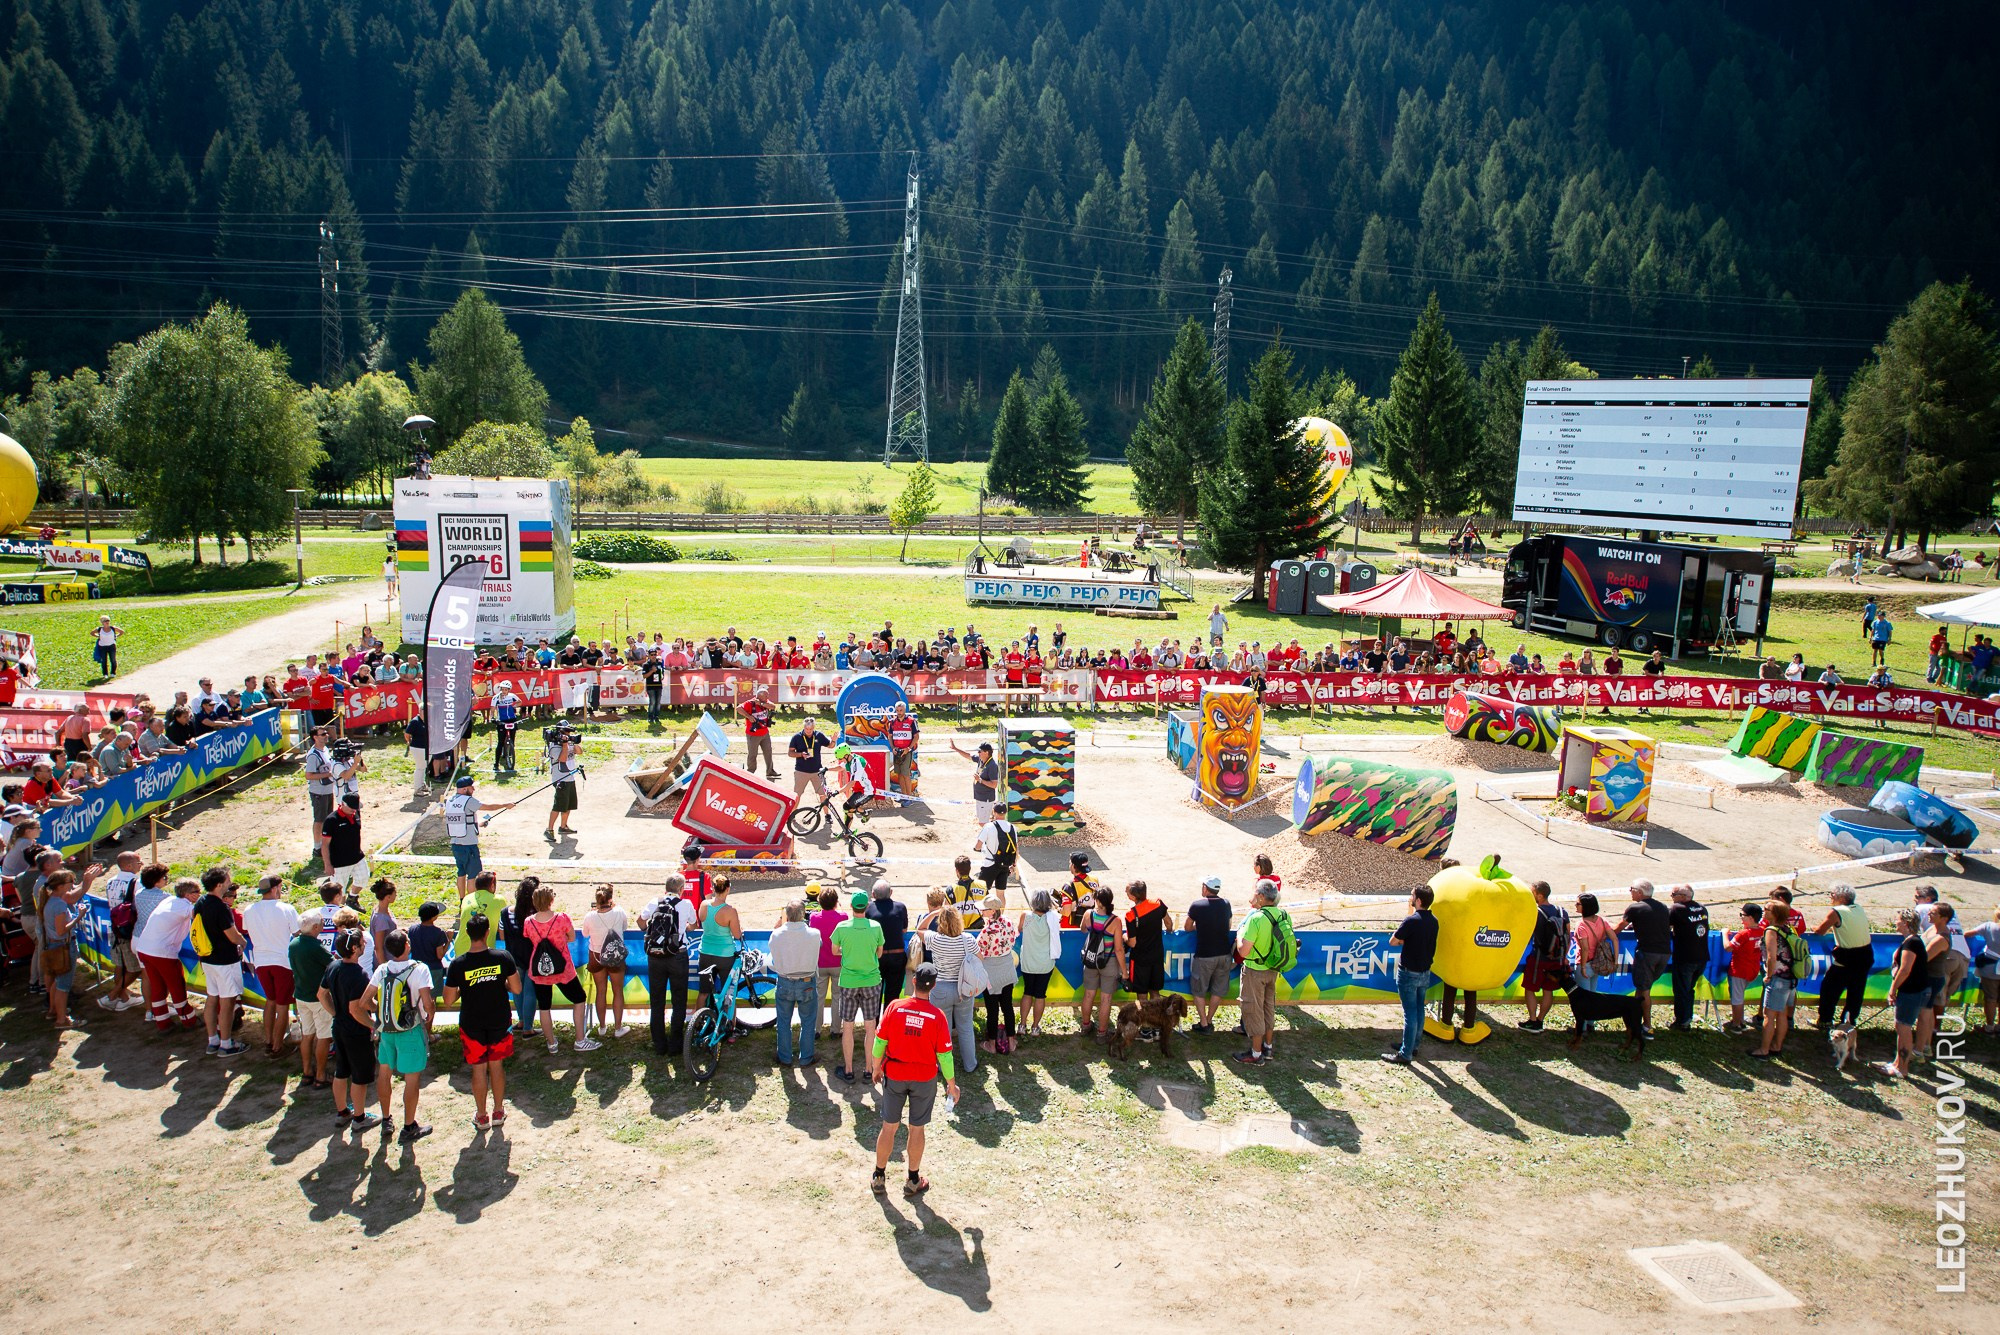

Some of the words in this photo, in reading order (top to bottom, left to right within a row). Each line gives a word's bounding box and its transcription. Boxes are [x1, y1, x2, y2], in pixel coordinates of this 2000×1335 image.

[445, 526, 502, 541] WORLD
[50, 550, 67, 563] Val
[68, 554, 75, 562] di
[1598, 547, 1632, 560] WATCH
[1634, 552, 1644, 562] IT
[1646, 553, 1662, 564] ON
[483, 584, 512, 592] TRIALS
[974, 582, 1013, 595] PEJO
[1607, 572, 1627, 586] Red
[1628, 574, 1648, 590] Bull
[51, 585, 84, 600] Melinda
[1022, 584, 1061, 598] PEJO
[1070, 586, 1109, 601] PEJO
[1119, 588, 1157, 602] PEJO
[1634, 591, 1646, 604] TV
[444, 596, 470, 630] 5
[510, 614, 551, 622] #TrialsWorlds
[438, 638, 462, 646] UCI
[518, 678, 550, 700] Val
[600, 685, 616, 699] di
[680, 676, 710, 698] Val
[712, 682, 724, 696] di
[786, 675, 815, 697] Val
[818, 682, 830, 696] di
[922, 683, 936, 696] di
[1096, 676, 1126, 700] Val
[1130, 682, 1144, 695] di
[1146, 674, 1194, 696] Sole
[1265, 677, 1297, 694] ole
[1302, 678, 1334, 700] Val
[1336, 686, 1350, 699] di
[1352, 677, 1400, 698] Sole
[1404, 680, 1438, 702] Val
[1439, 687, 1453, 700] di
[1505, 680, 1536, 702] Val
[1538, 688, 1552, 700] di
[1553, 677, 1600, 699] Sole
[1604, 682, 1638, 704] Val
[1638, 688, 1652, 701] di
[1654, 680, 1703, 700] Sole
[444, 658, 456, 740] #TrialsWorlds
[1706, 684, 1740, 706] Val
[1742, 692, 1757, 704] di
[1758, 683, 1812, 706] Sole
[1816, 690, 1855, 712] Val
[1857, 699, 1875, 712] di
[1876, 692, 1936, 714] Sole
[850, 705, 896, 714] TRENTINO
[1942, 700, 1976, 726] Val
[1978, 715, 1994, 728] di
[26, 729, 42, 744] di
[204, 732, 248, 765] TRENTINO
[134, 762, 182, 800] TRENTINO
[706, 788, 726, 812] Val
[724, 806, 736, 816] di
[734, 804, 768, 831] Sole
[52, 798, 104, 844] TRENTINO
[1476, 933, 1510, 942] Melinda
[1322, 946, 1402, 980] TRENT
[469, 967, 498, 978] JITSIE
